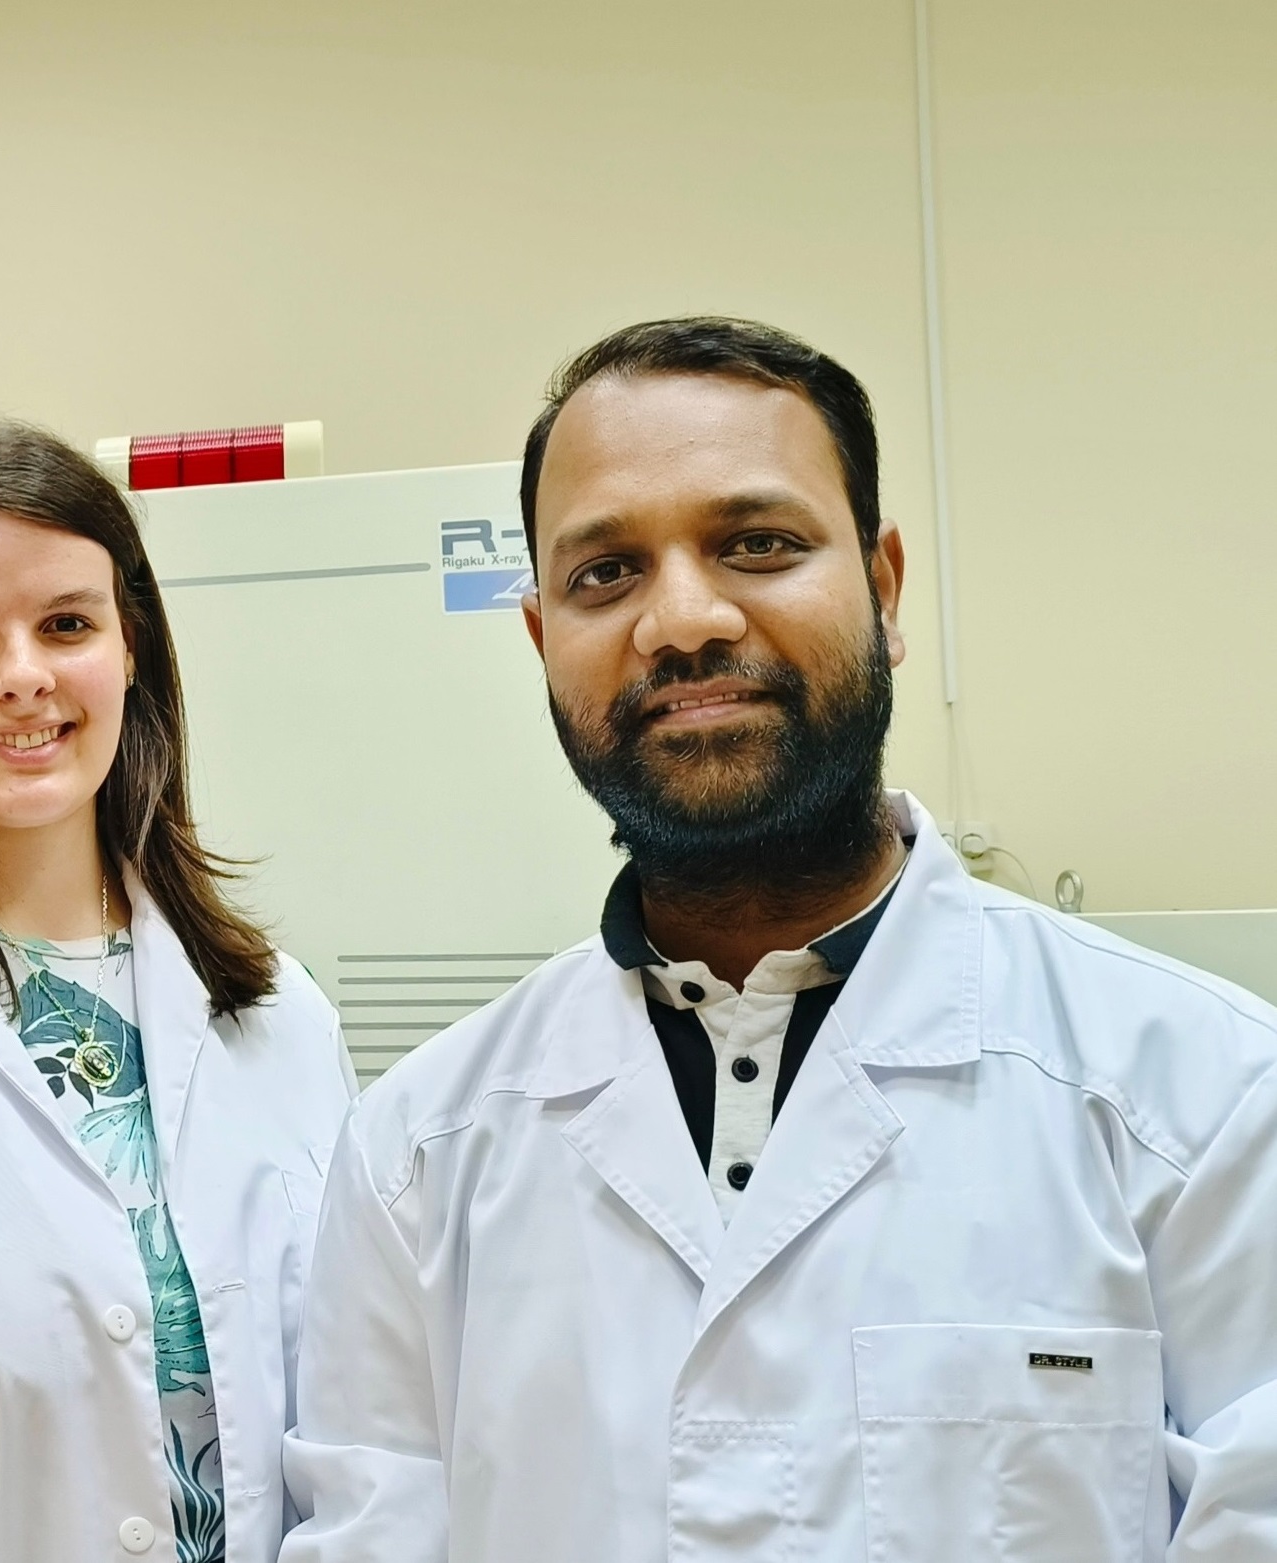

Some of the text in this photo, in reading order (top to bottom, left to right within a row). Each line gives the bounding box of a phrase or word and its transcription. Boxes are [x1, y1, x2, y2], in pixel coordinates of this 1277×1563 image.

[442, 554, 524, 569] Rigaku X-ray
[1055, 1356, 1088, 1368] STYLE
